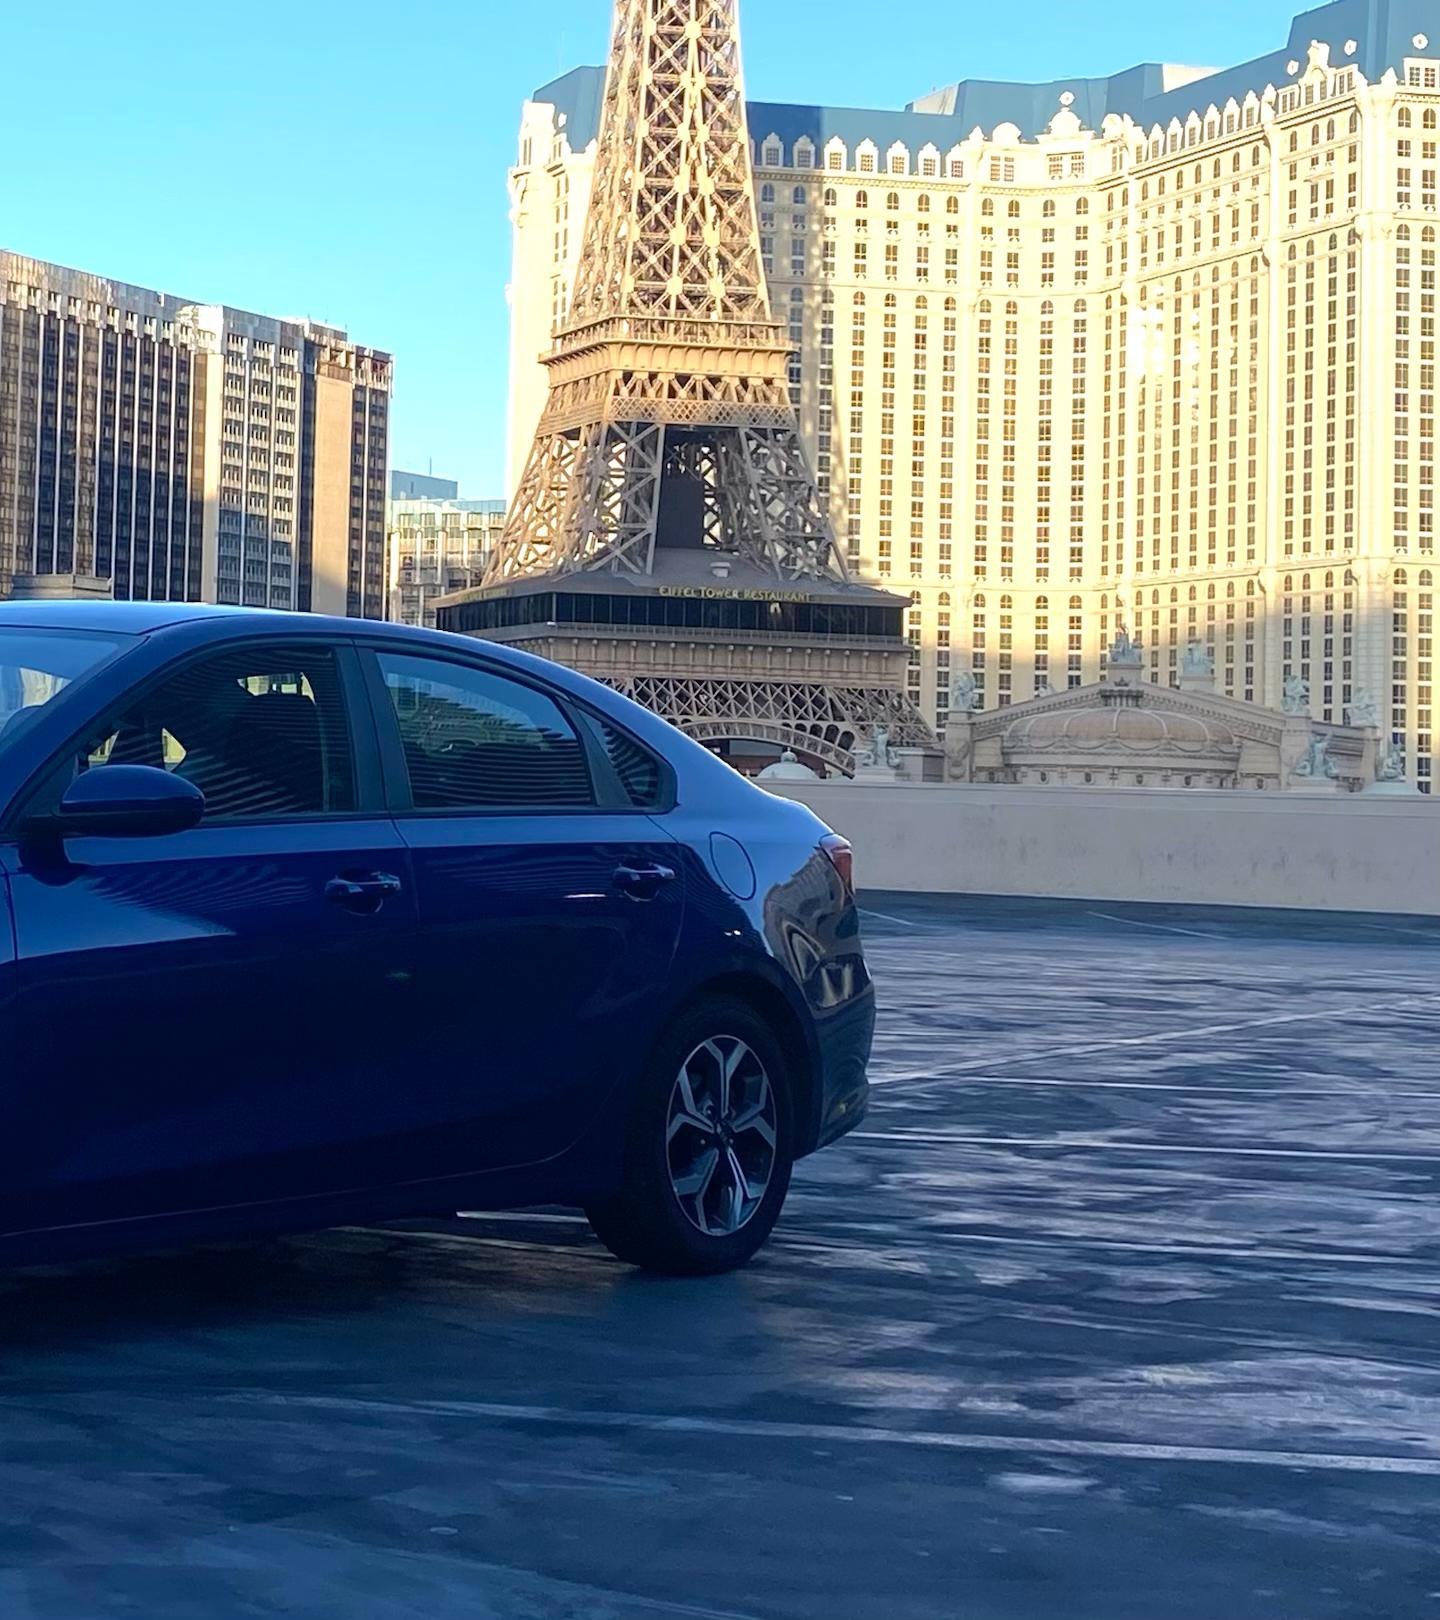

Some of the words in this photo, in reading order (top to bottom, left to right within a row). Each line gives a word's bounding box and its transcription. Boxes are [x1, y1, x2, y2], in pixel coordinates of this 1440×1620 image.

[660, 585, 698, 597] EIFFEL
[700, 586, 739, 599] TOWER
[743, 588, 810, 602] RESTAURANT
